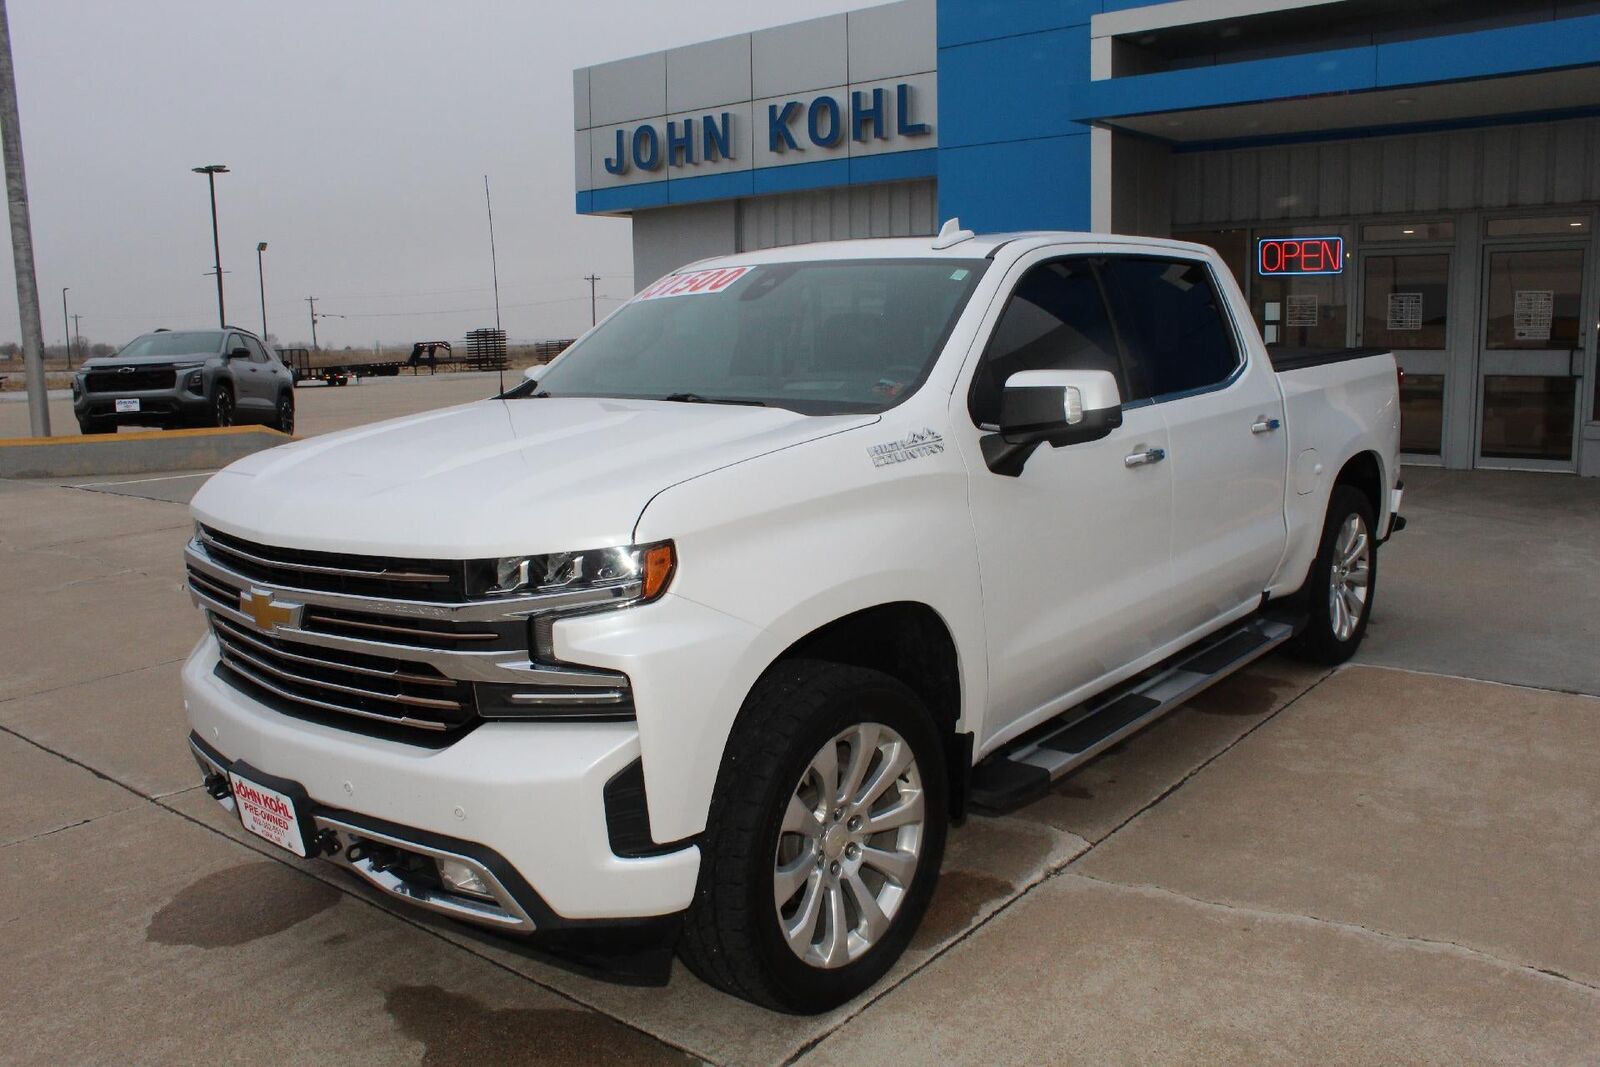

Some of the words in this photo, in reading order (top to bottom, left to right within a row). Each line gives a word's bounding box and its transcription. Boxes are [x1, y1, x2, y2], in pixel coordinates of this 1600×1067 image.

[604, 112, 736, 176] JOHN
[768, 83, 931, 154] KOHL
[1263, 240, 1340, 271] OPEN
[872, 442, 944, 468] COUNTRY
[234, 783, 262, 804] JOHN
[262, 794, 294, 819] KOHL
[243, 802, 289, 831] PRE-OWNED
